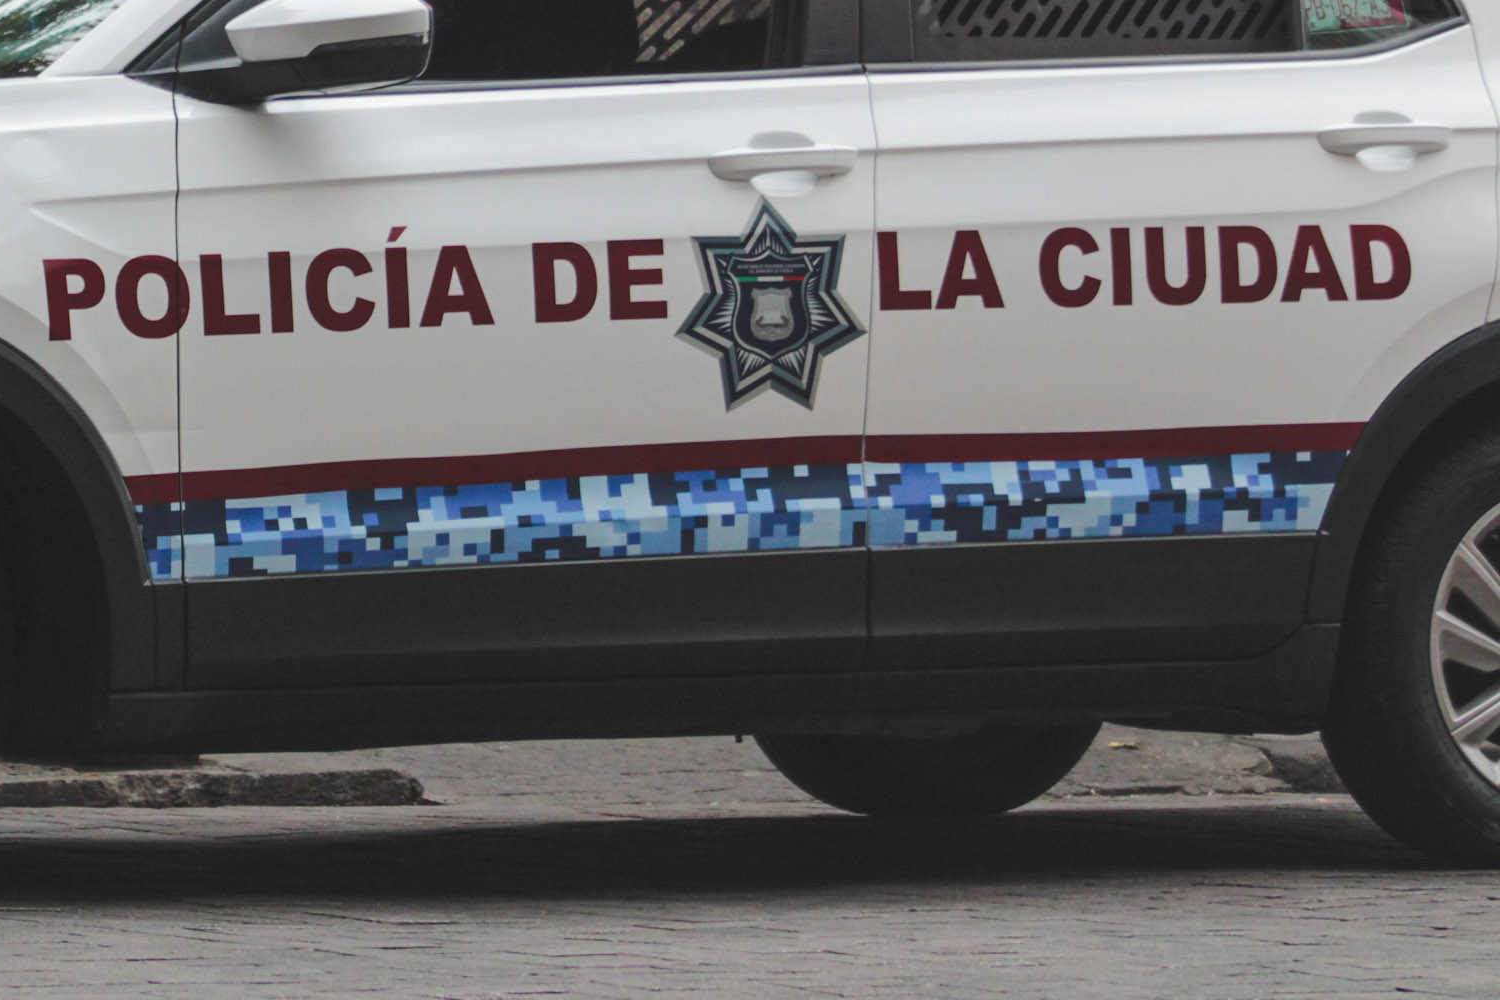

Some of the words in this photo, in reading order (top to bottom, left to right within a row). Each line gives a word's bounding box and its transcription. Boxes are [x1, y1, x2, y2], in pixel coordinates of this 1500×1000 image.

[43, 226, 495, 341] POLICÍA
[531, 238, 668, 324] DE
[876, 230, 1005, 311] LA
[1039, 224, 1412, 308] CIUDAD
